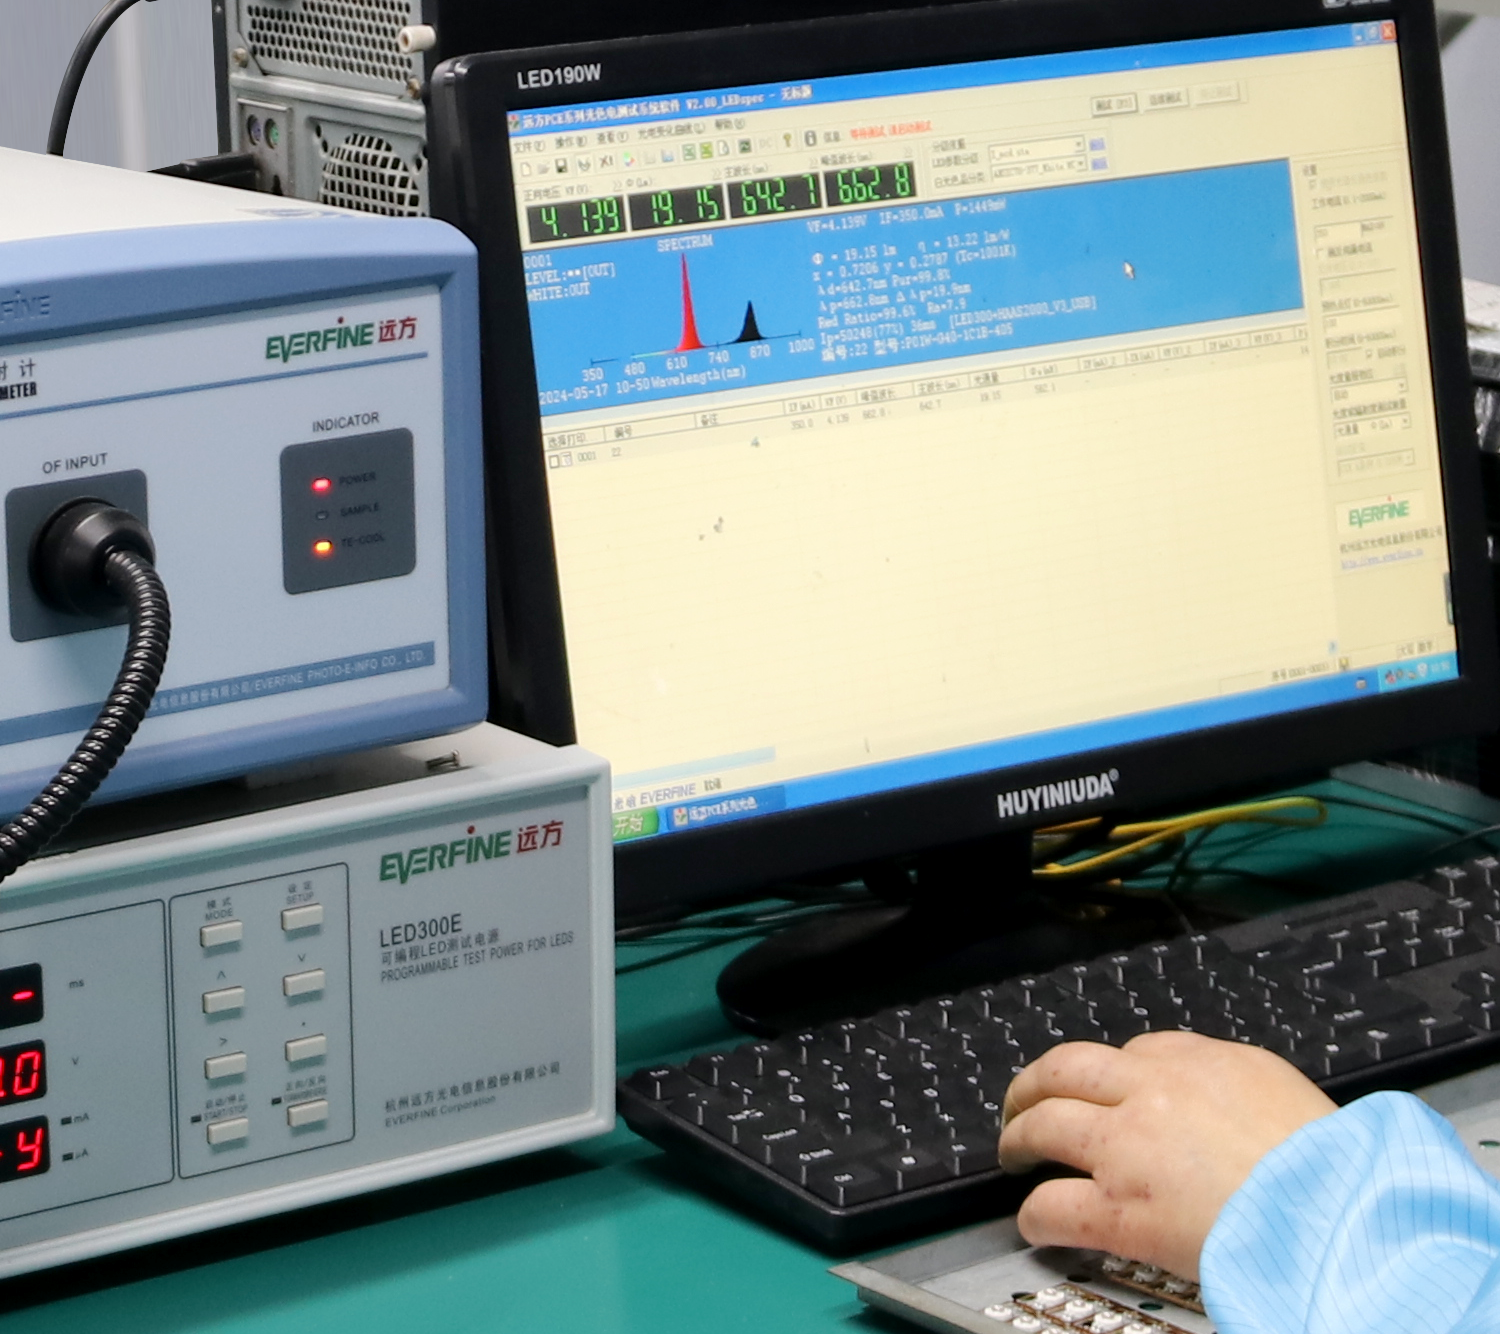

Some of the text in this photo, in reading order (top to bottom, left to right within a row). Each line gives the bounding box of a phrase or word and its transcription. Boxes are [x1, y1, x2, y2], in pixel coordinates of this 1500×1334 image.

[517, 64, 601, 89] LED190W
[741, 173, 817, 215] 642.7
[837, 162, 911, 204] 662.8
[541, 197, 620, 237] 4.139
[652, 185, 719, 225] 19.15
[657, 234, 713, 253] SPECTRUM
[266, 317, 417, 363] EVERFINE 远方
[582, 339, 816, 382] 350 480 610 740 870 1000
[539, 365, 746, 405] 2024-05-17 10-50 Wavelength(nm)
[312, 412, 379, 433] INDICATOR
[42, 452, 108, 474] OF INPUT
[1349, 497, 1409, 528] EVERFINE
[640, 783, 696, 805] EVERFINE
[997, 772, 1114, 818] HUYINIUDA
[613, 813, 643, 836] 开始
[379, 820, 563, 884] EVERFINE 远方
[205, 908, 234, 919] MODE
[380, 913, 462, 948] LED300E
[381, 930, 574, 983] PROGRAMMABLE TEST POWER FOR LEDS
[382, 928, 499, 966] 可编程LED测试电源
[69, 979, 84, 989] ms
[73, 1113, 89, 1124] mA
[385, 1095, 496, 1128] EVERFINE Corporation
